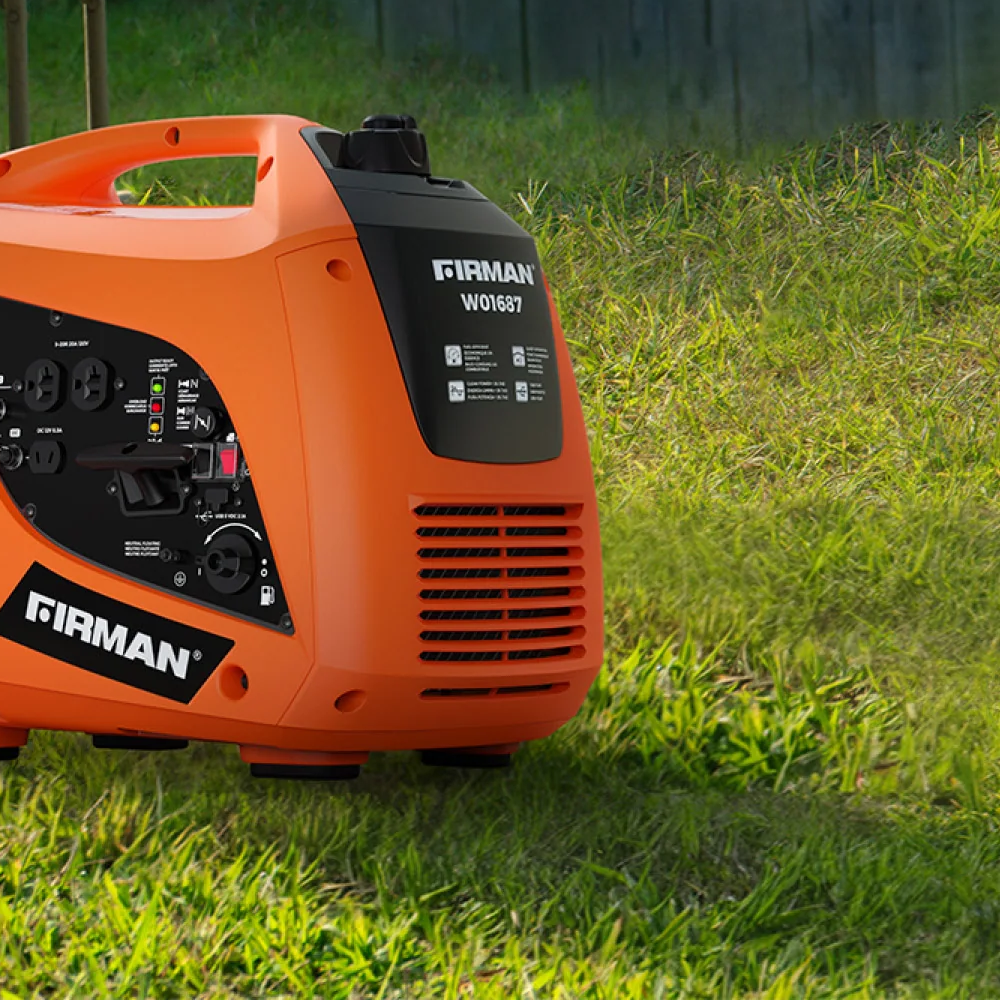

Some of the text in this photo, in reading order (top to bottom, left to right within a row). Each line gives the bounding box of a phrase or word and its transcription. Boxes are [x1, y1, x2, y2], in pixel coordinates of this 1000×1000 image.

[431, 259, 535, 286] FIRMAN
[460, 293, 522, 314] W01687
[25, 590, 190, 680] FIRMAN
